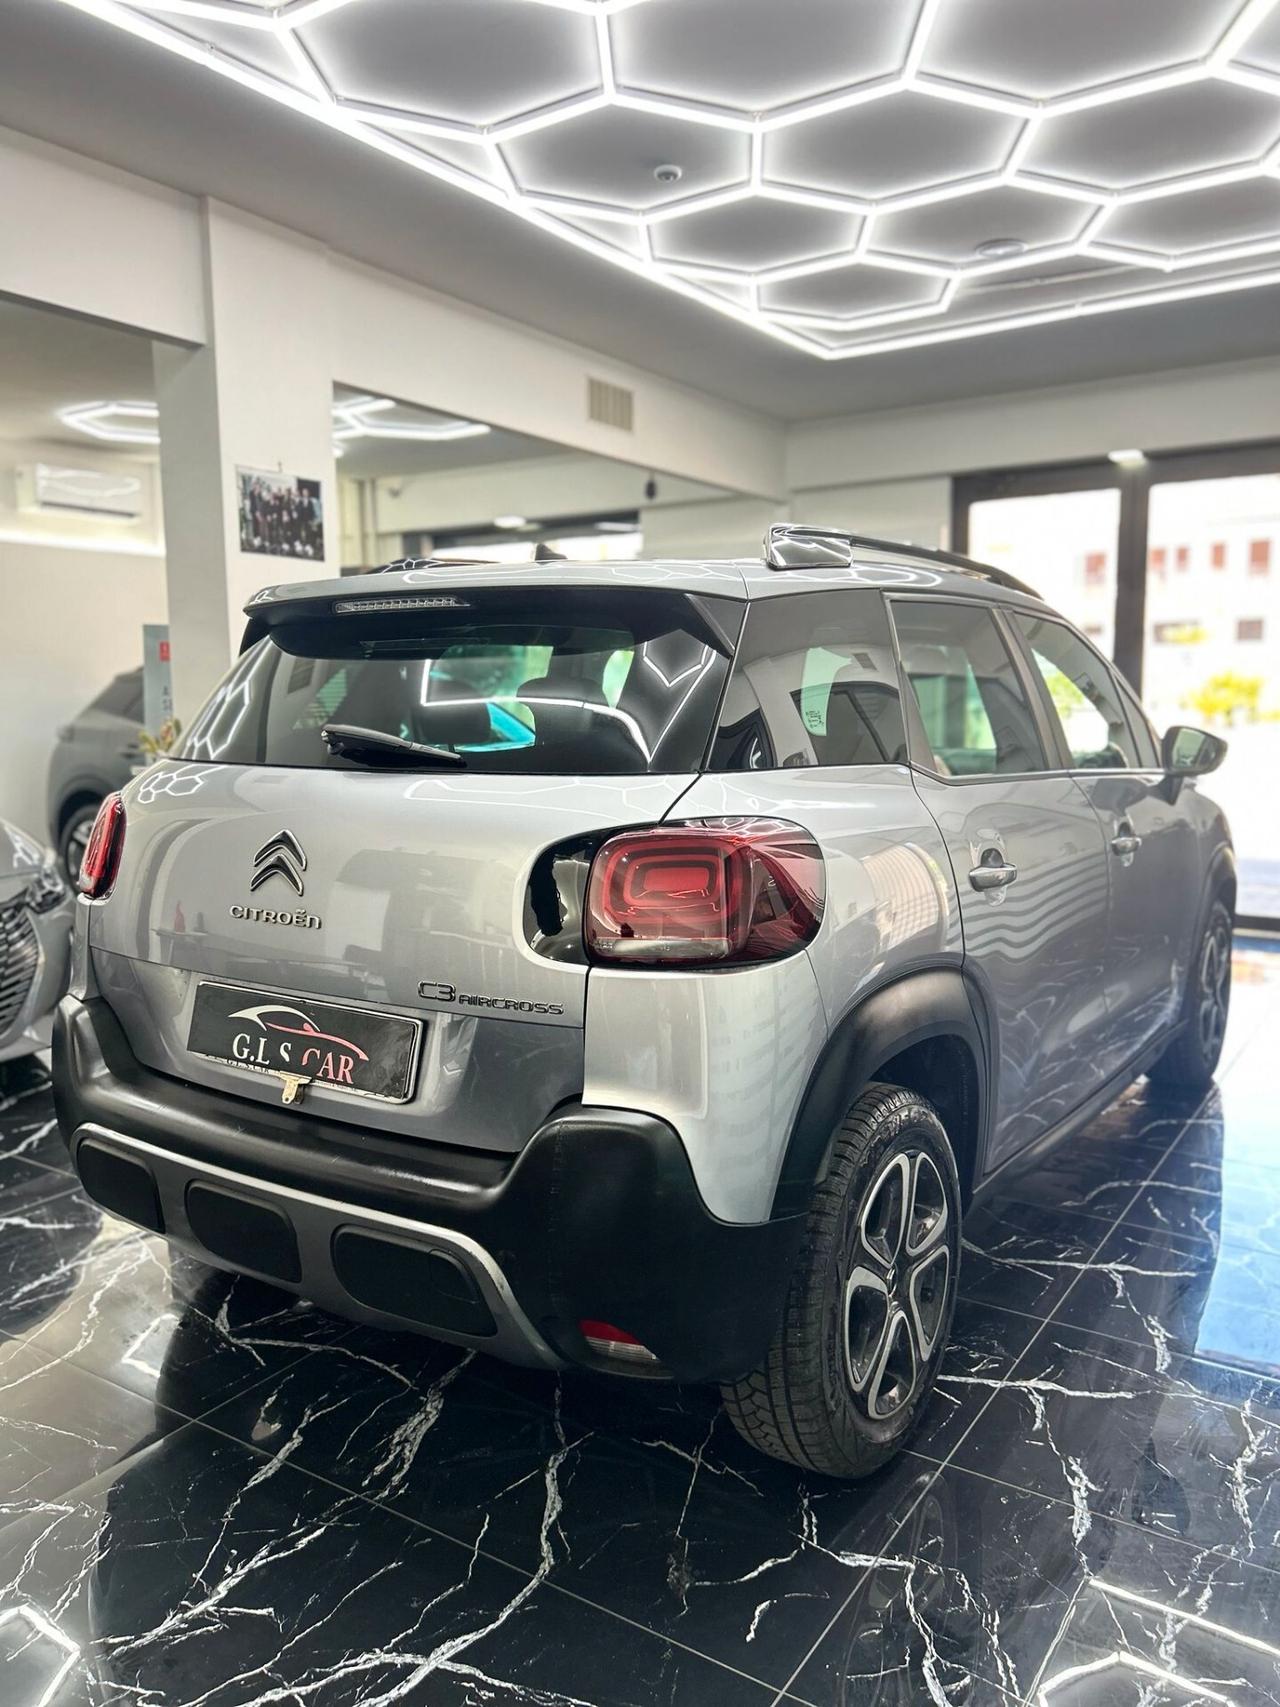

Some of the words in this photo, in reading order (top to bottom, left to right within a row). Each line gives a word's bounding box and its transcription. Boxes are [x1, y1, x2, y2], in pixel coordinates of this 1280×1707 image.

[417, 980, 457, 1002] C3
[458, 994, 565, 1016] AIRCROSS
[301, 1048, 354, 1085] CAR
